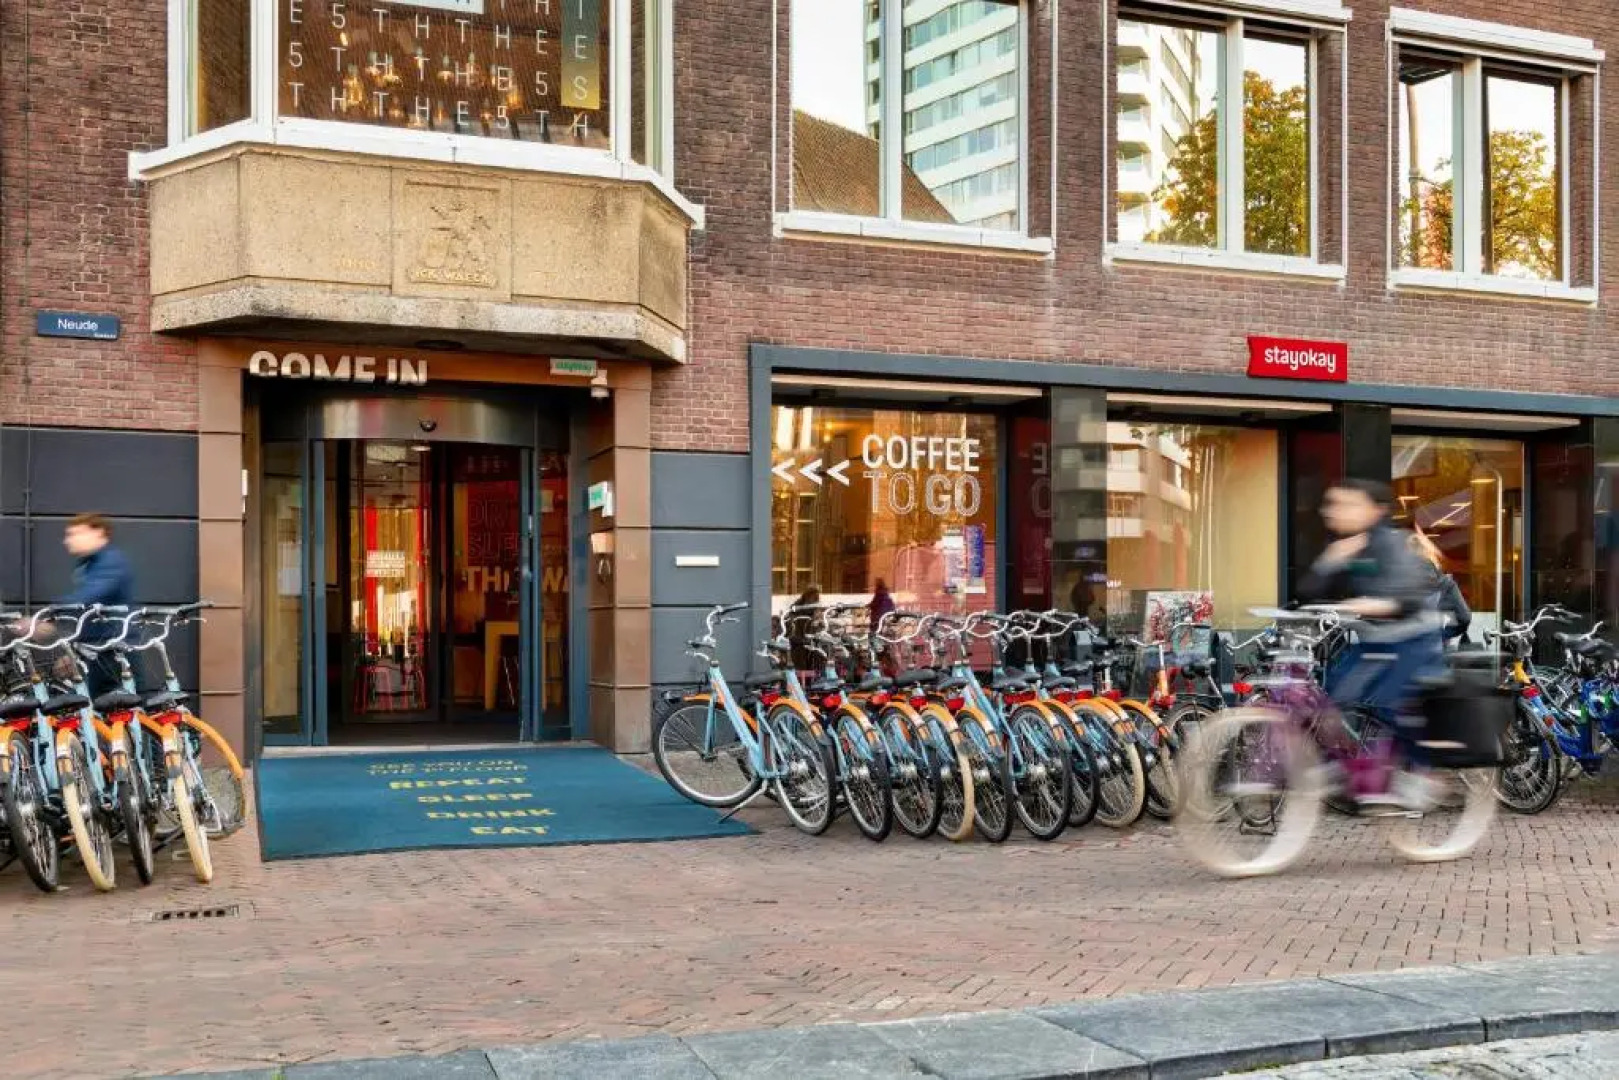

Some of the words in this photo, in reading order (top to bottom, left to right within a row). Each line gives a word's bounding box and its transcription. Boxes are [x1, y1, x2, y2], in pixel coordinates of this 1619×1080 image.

[57, 318, 98, 331] Neude
[1264, 345, 1336, 374] stayokay
[249, 351, 376, 383] COME
[387, 358, 427, 386] IN
[863, 433, 981, 472] COFFEE
[863, 469, 915, 515] TO
[926, 473, 981, 517] GO
[388, 777, 526, 789] REPEAT
[417, 793, 533, 803] SLEEP
[426, 808, 557, 819] DRINK
[470, 826, 549, 835] EAT
